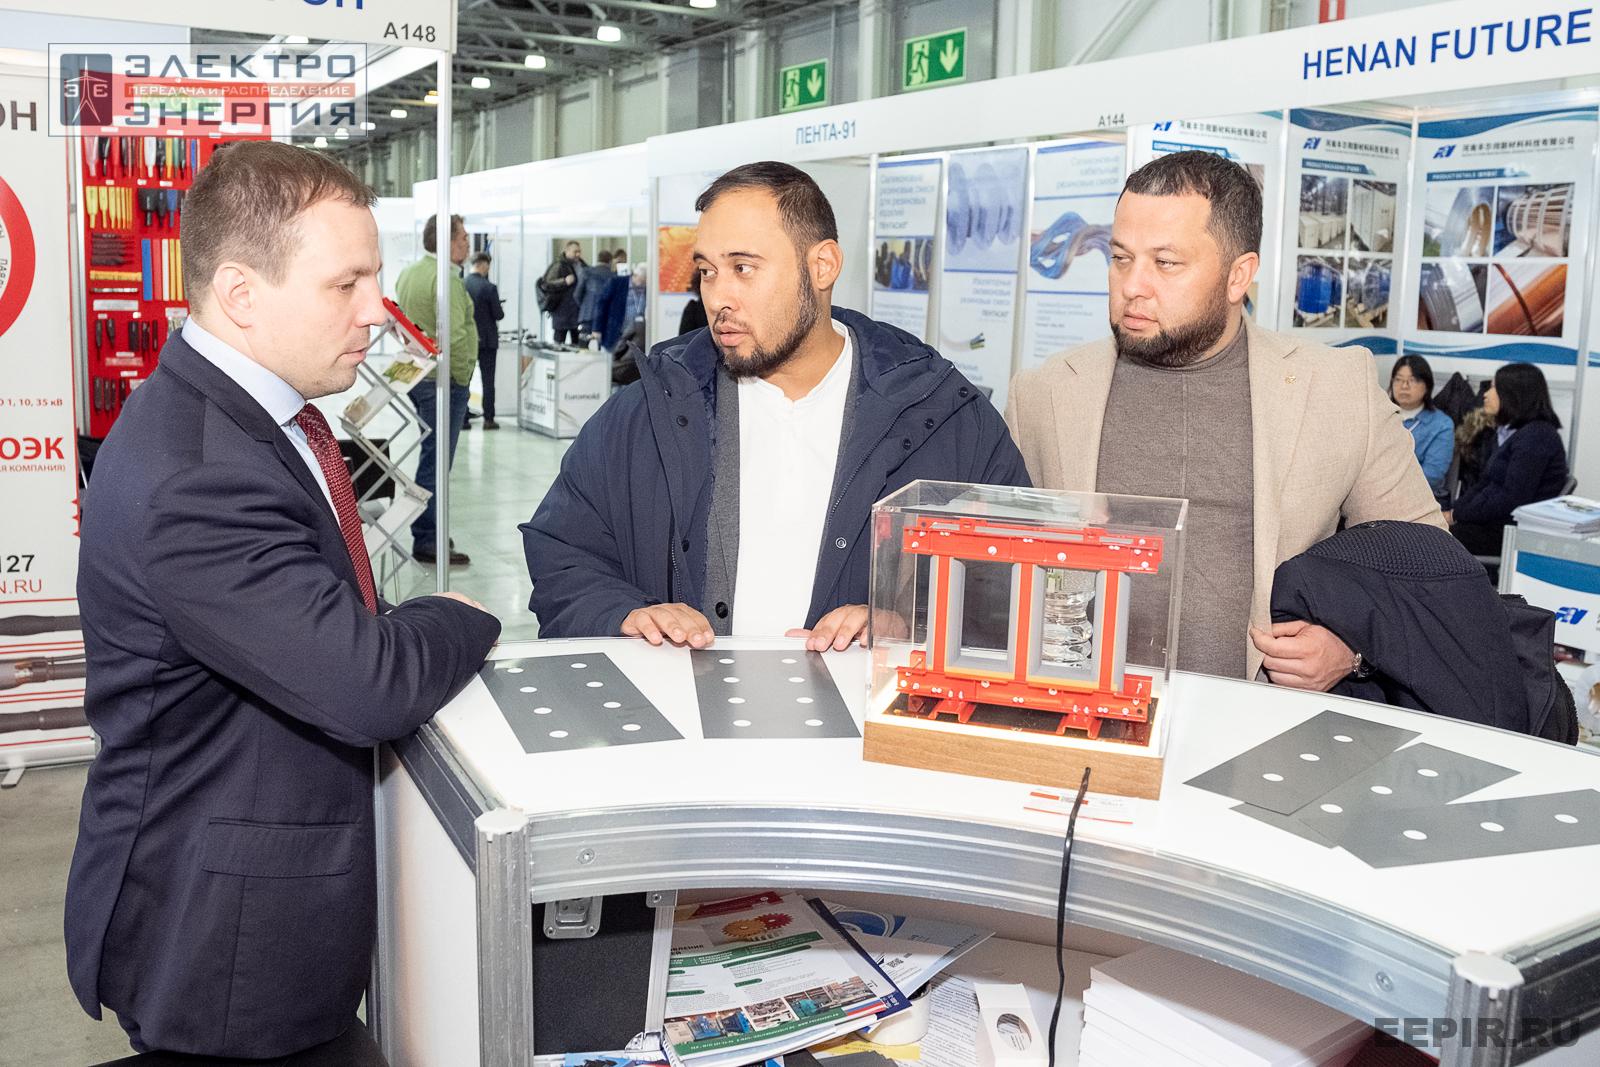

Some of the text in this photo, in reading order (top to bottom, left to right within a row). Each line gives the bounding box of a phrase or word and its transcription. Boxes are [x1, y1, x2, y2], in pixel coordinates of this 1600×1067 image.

[383, 22, 436, 43] A148
[1303, 8, 1593, 80] HENAN FUTURE
[796, 120, 856, 145] ПЕНТА-91
